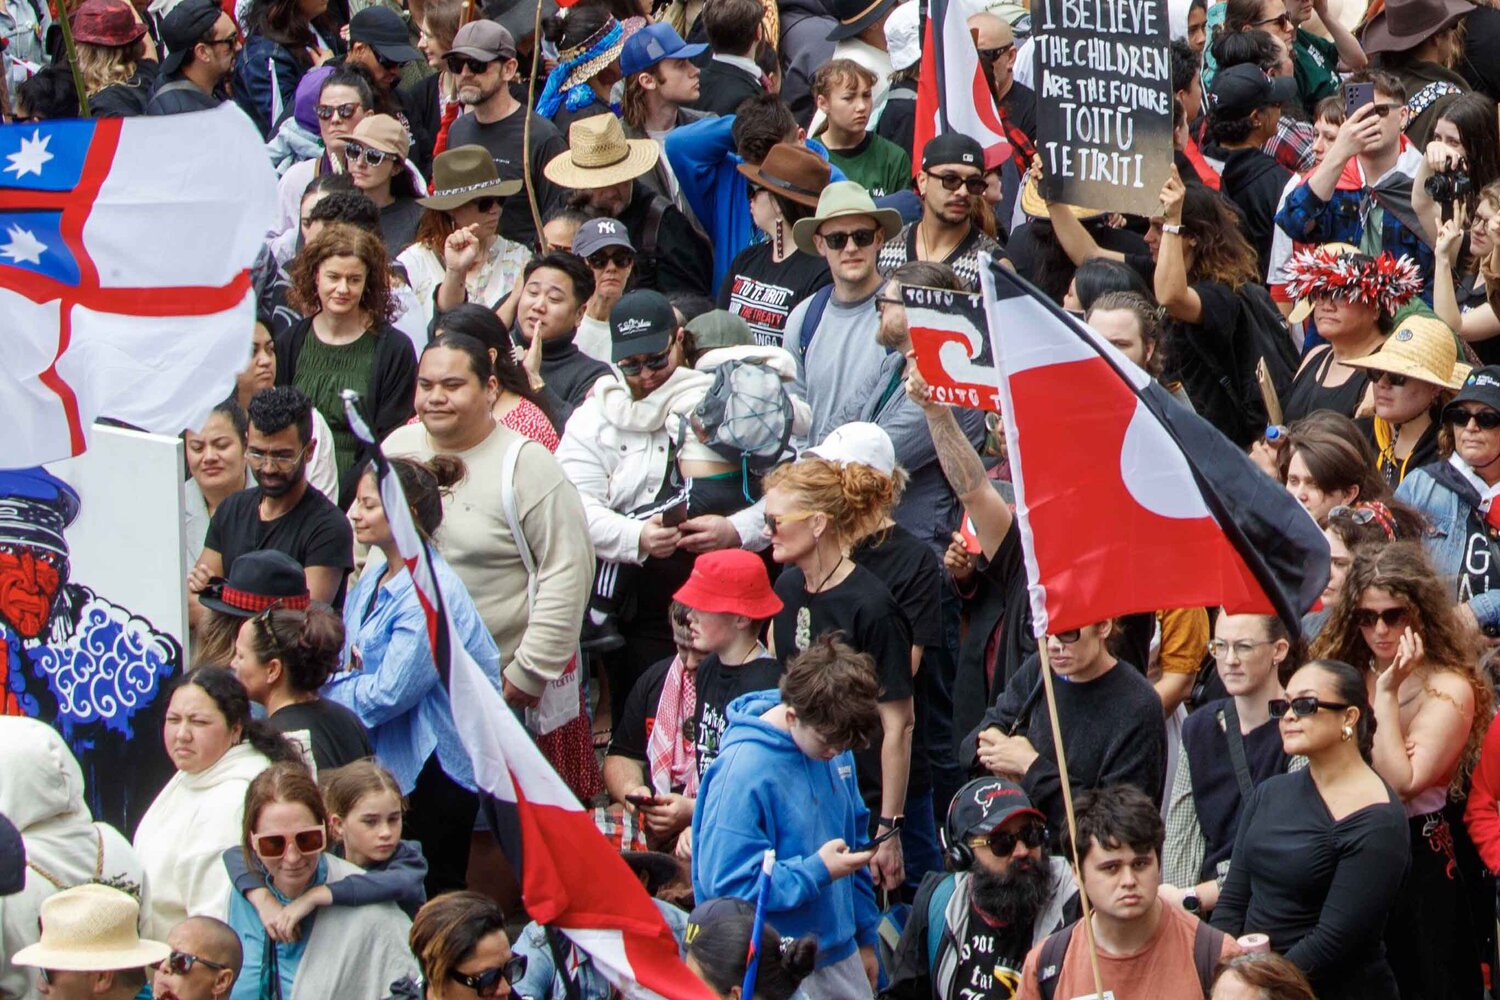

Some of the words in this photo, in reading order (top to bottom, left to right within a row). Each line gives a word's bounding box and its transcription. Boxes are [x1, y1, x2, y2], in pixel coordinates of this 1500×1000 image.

[1035, 35, 1071, 67] THE
[1074, 37, 1168, 80] CHILDREN
[1042, 70, 1074, 99] ARE
[1077, 78, 1107, 104] THE
[1110, 80, 1169, 115] FUTURE
[1060, 103, 1133, 151] TOITŪ
[1045, 142, 1074, 178] TE
[1078, 148, 1144, 188] TIRITI
